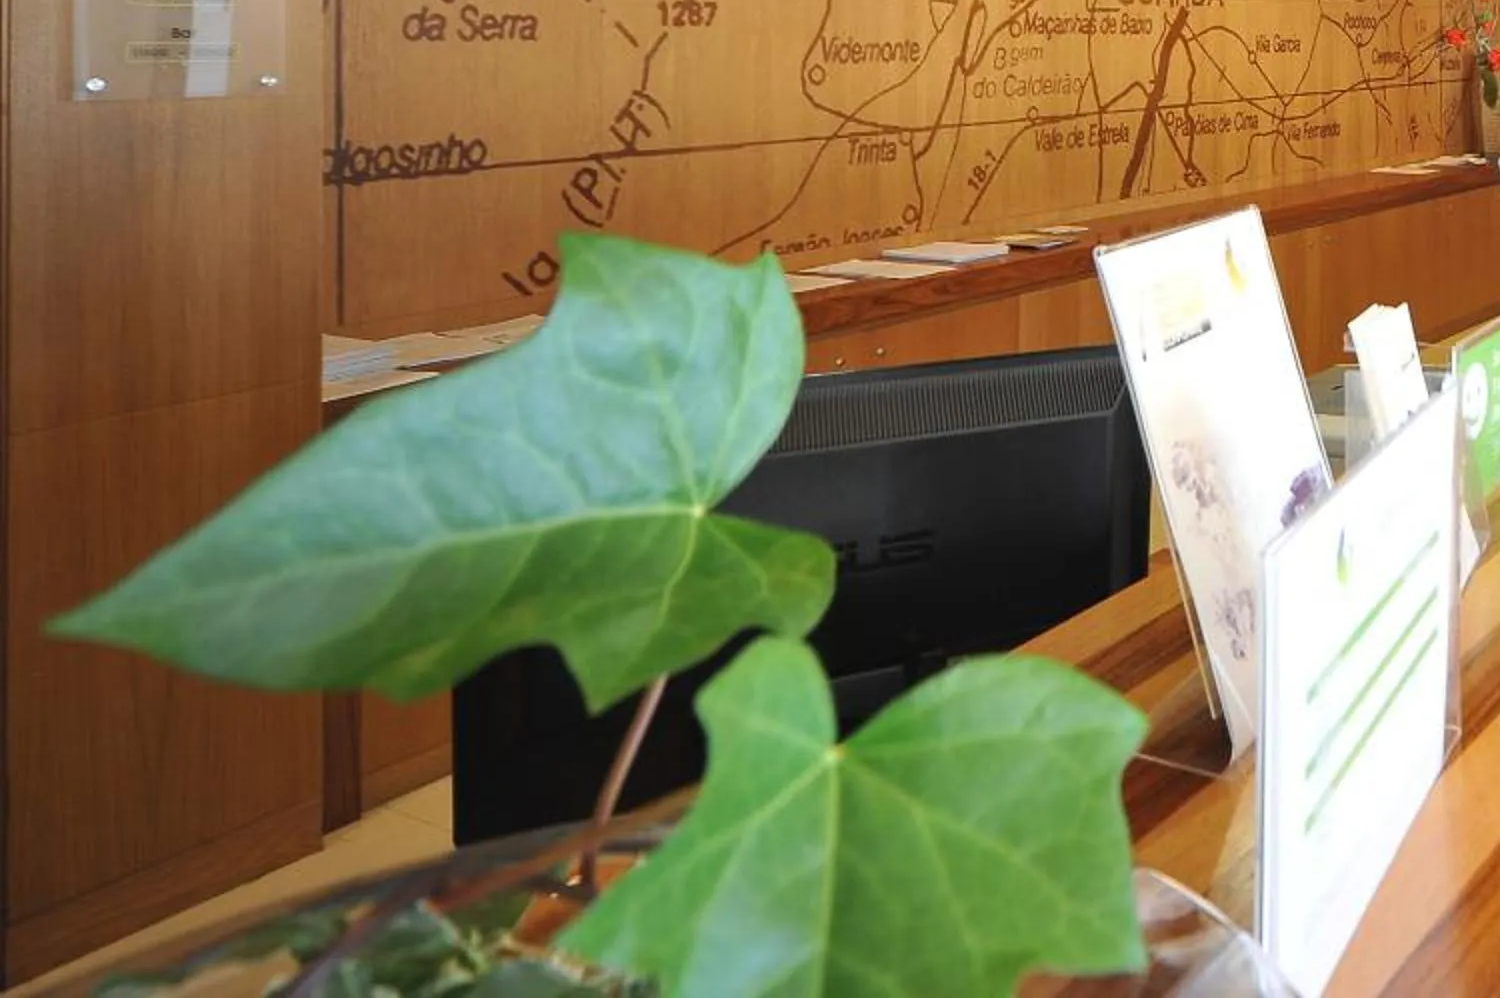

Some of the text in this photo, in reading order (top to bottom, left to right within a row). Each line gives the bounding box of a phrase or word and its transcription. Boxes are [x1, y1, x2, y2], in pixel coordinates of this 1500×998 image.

[402, 4, 538, 42] da Serra
[657, 0, 718, 27] 1287
[1101, 16, 1117, 35] de
[821, 36, 921, 64] Videmonte
[972, 77, 996, 99] do
[1035, 128, 1064, 152] Vale
[1067, 126, 1084, 149] de
